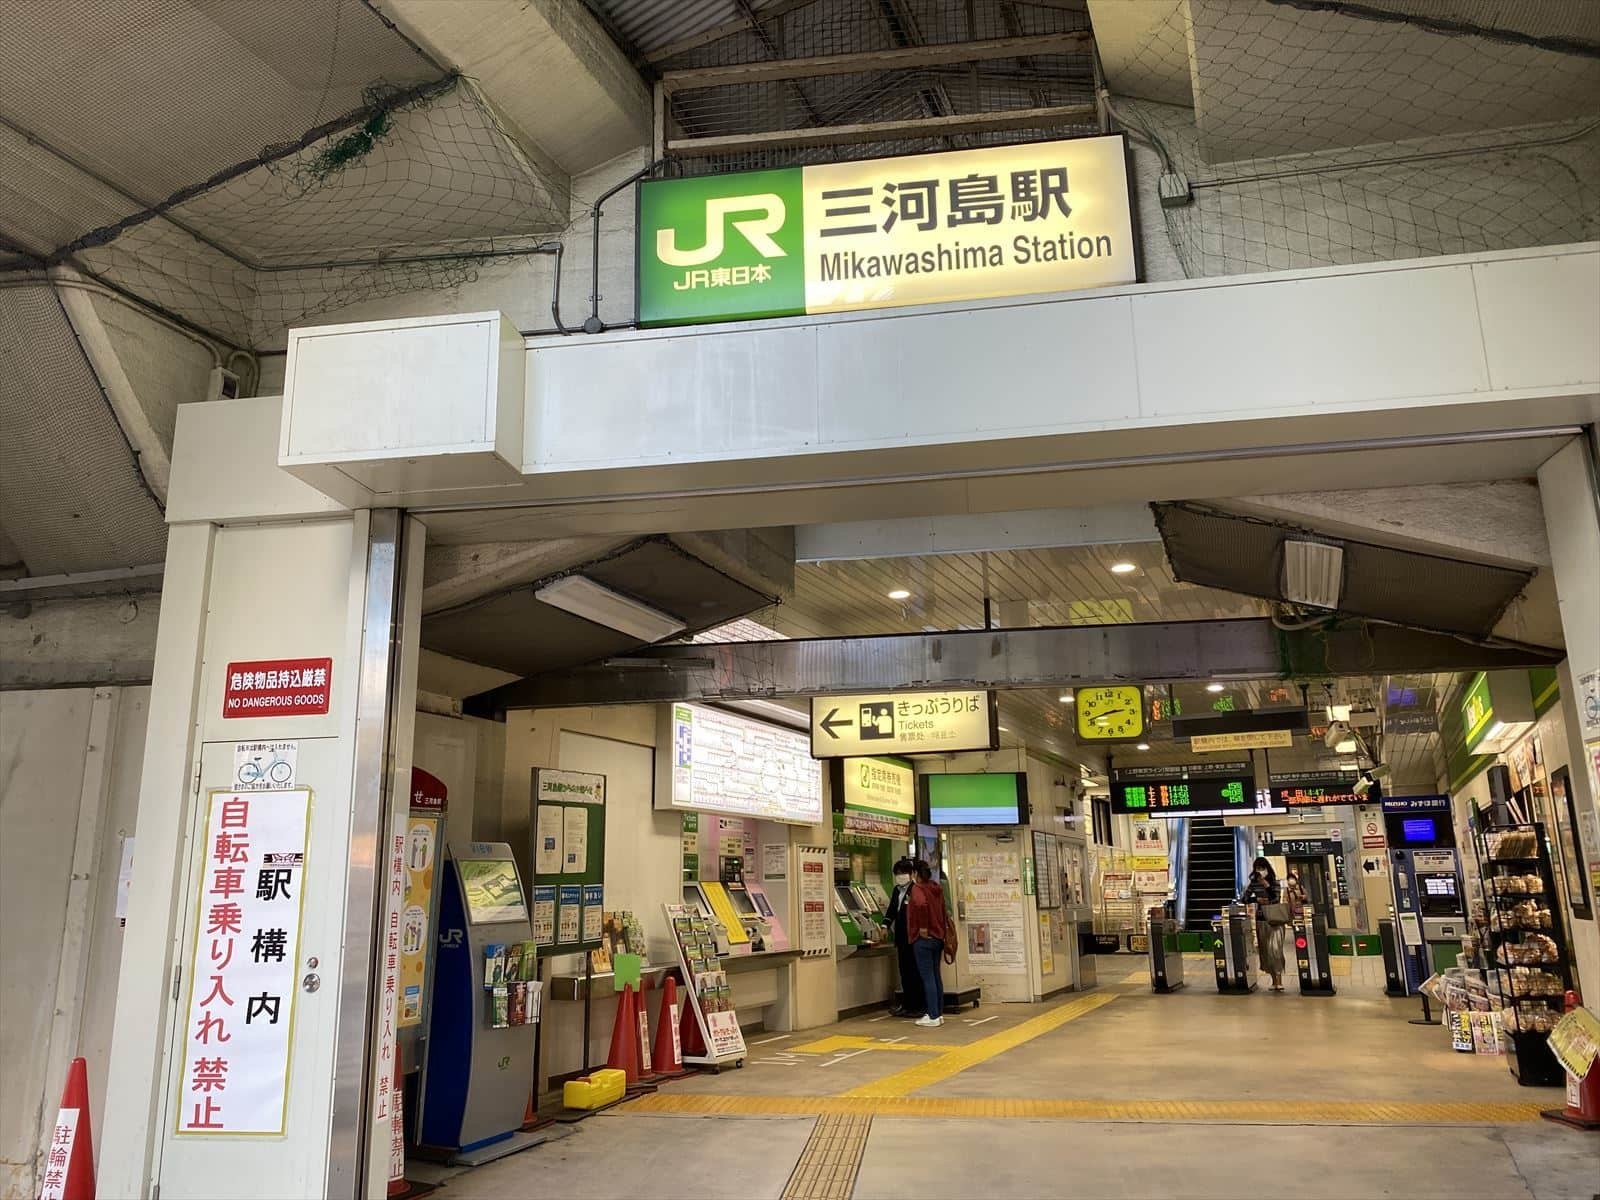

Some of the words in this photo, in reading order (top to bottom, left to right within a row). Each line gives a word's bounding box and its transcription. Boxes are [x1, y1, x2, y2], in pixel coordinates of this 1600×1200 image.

[820, 166, 1072, 238] 三河島駅
[656, 193, 788, 266] JR
[820, 239, 1002, 282] Mikawashima
[1013, 231, 1113, 265] Station
[673, 263, 772, 291] JR東日本
[230, 668, 327, 691] 危険物品持込厳禁
[228, 697, 241, 709] NO
[242, 695, 293, 708] DANGEROUS
[294, 693, 325, 705] GOODS
[897, 694, 980, 717] きっぷうりば
[899, 719, 934, 730] Tickets
[246, 869, 292, 1025] 駅構内
[439, 928, 464, 944] JR
